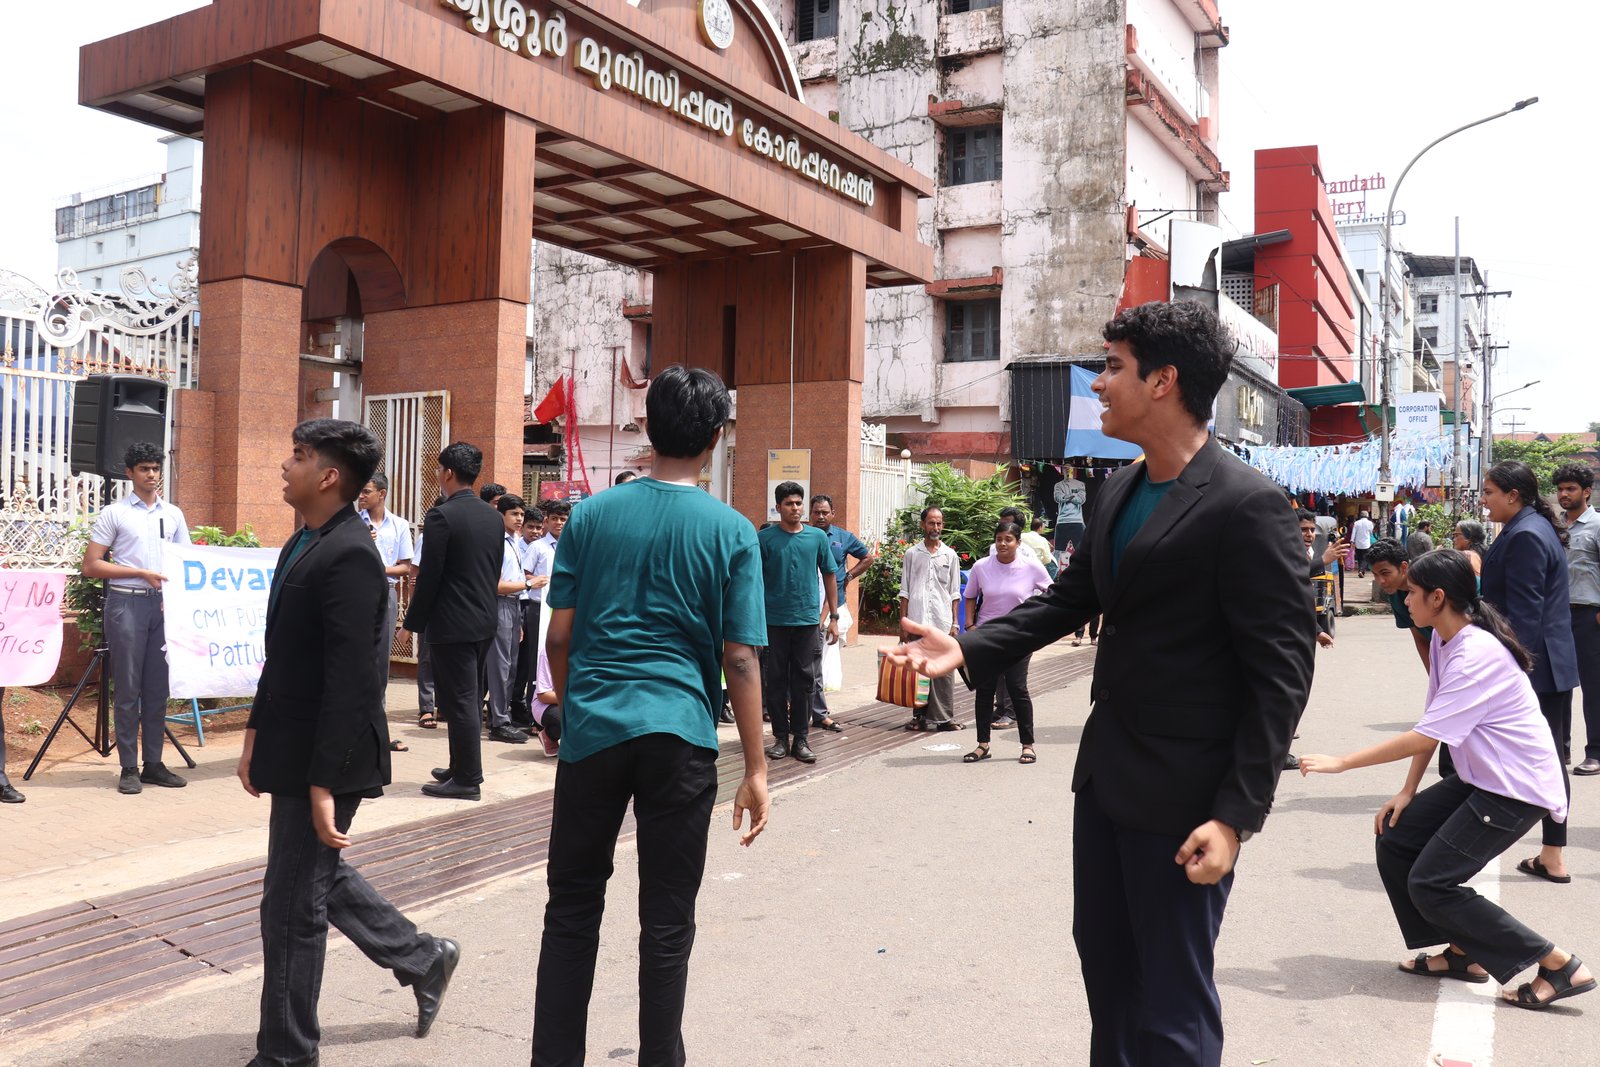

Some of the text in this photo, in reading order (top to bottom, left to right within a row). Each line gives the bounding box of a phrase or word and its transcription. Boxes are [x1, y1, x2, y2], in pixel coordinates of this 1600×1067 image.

[446, 0, 875, 207] ൃശ്ശൂർ മുനിസിപ്പൽ കോർപ്പറേഷൻ
[1398, 404, 1438, 413] CORPORATION
[1408, 415, 1428, 423] OFFICE
[25, 581, 55, 608] No
[193, 608, 227, 629] CMI
[208, 641, 266, 667] Pattu
